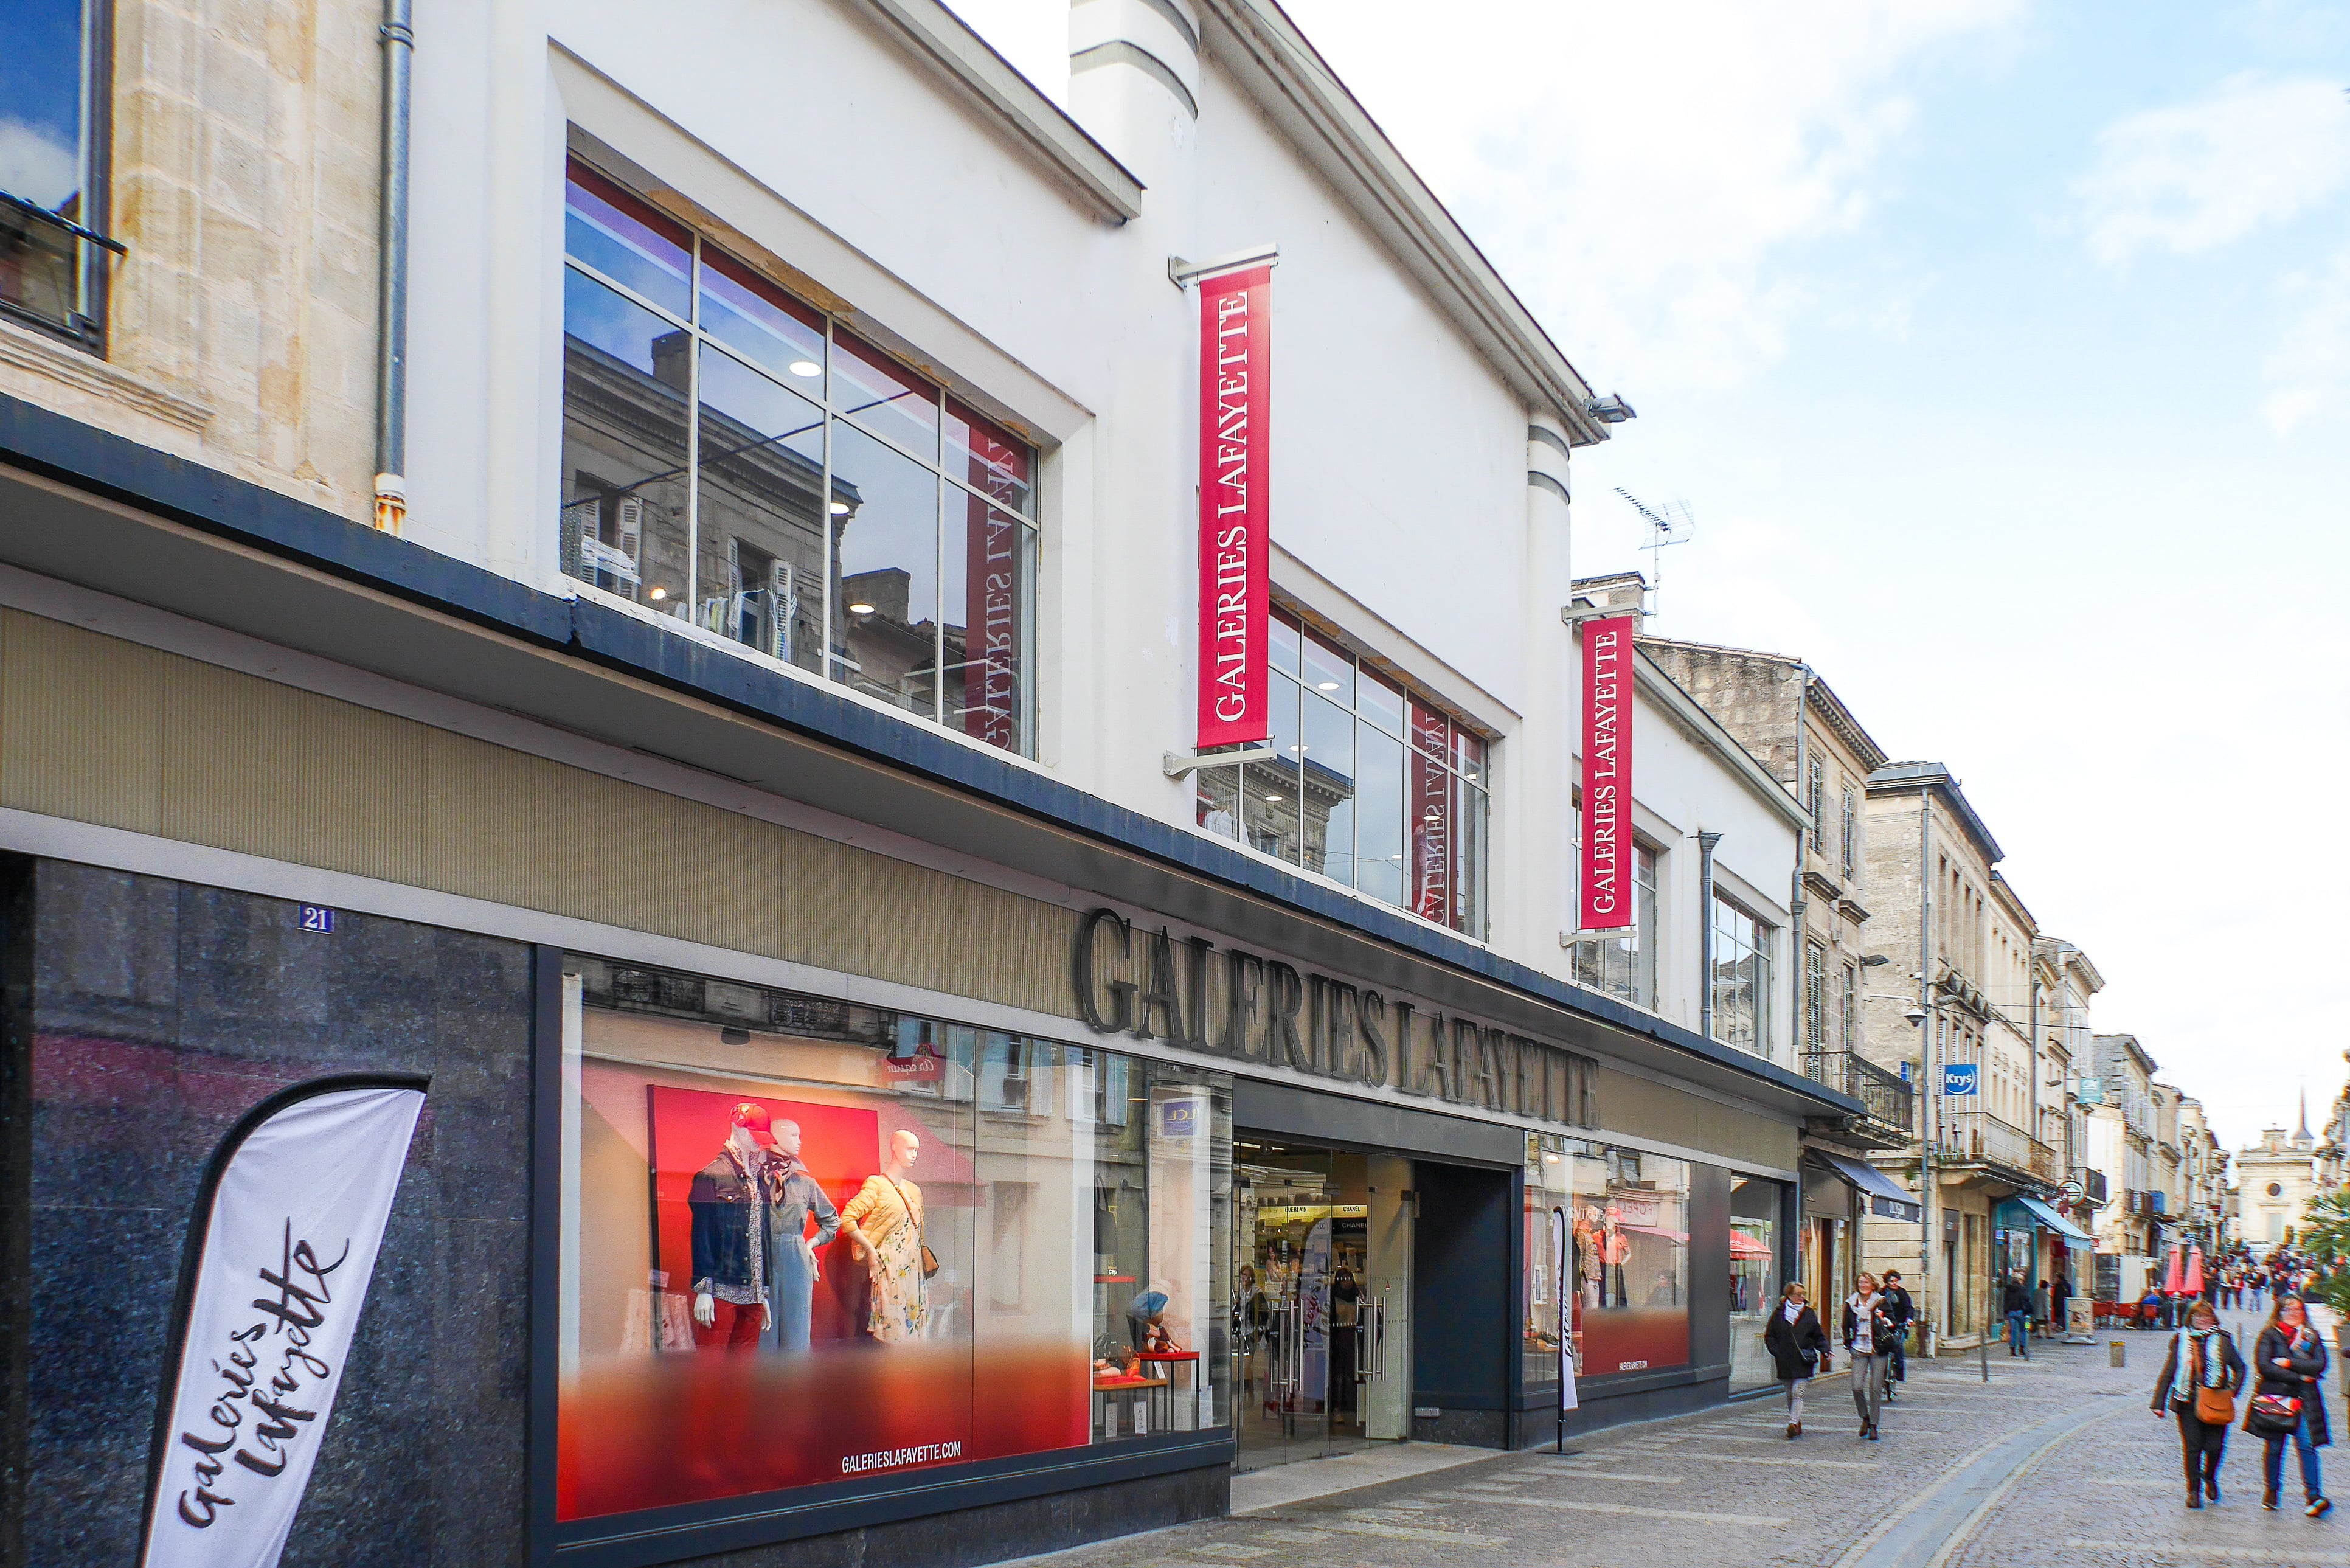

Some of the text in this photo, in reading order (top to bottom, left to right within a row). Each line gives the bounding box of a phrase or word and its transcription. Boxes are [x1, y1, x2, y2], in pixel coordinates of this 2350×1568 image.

[1216, 290, 1249, 723] GALERIES LAFAYETTE
[1593, 631, 1617, 914] GALERIES LAFAYETTE
[304, 907, 327, 929] 21
[1079, 907, 1602, 1130] GALERIES LAFAYETTE
[1946, 1073, 1972, 1086] Krys
[234, 1216, 350, 1478] Lafayette
[842, 1440, 962, 1473] GALERIESLAFAYETTE.COM
